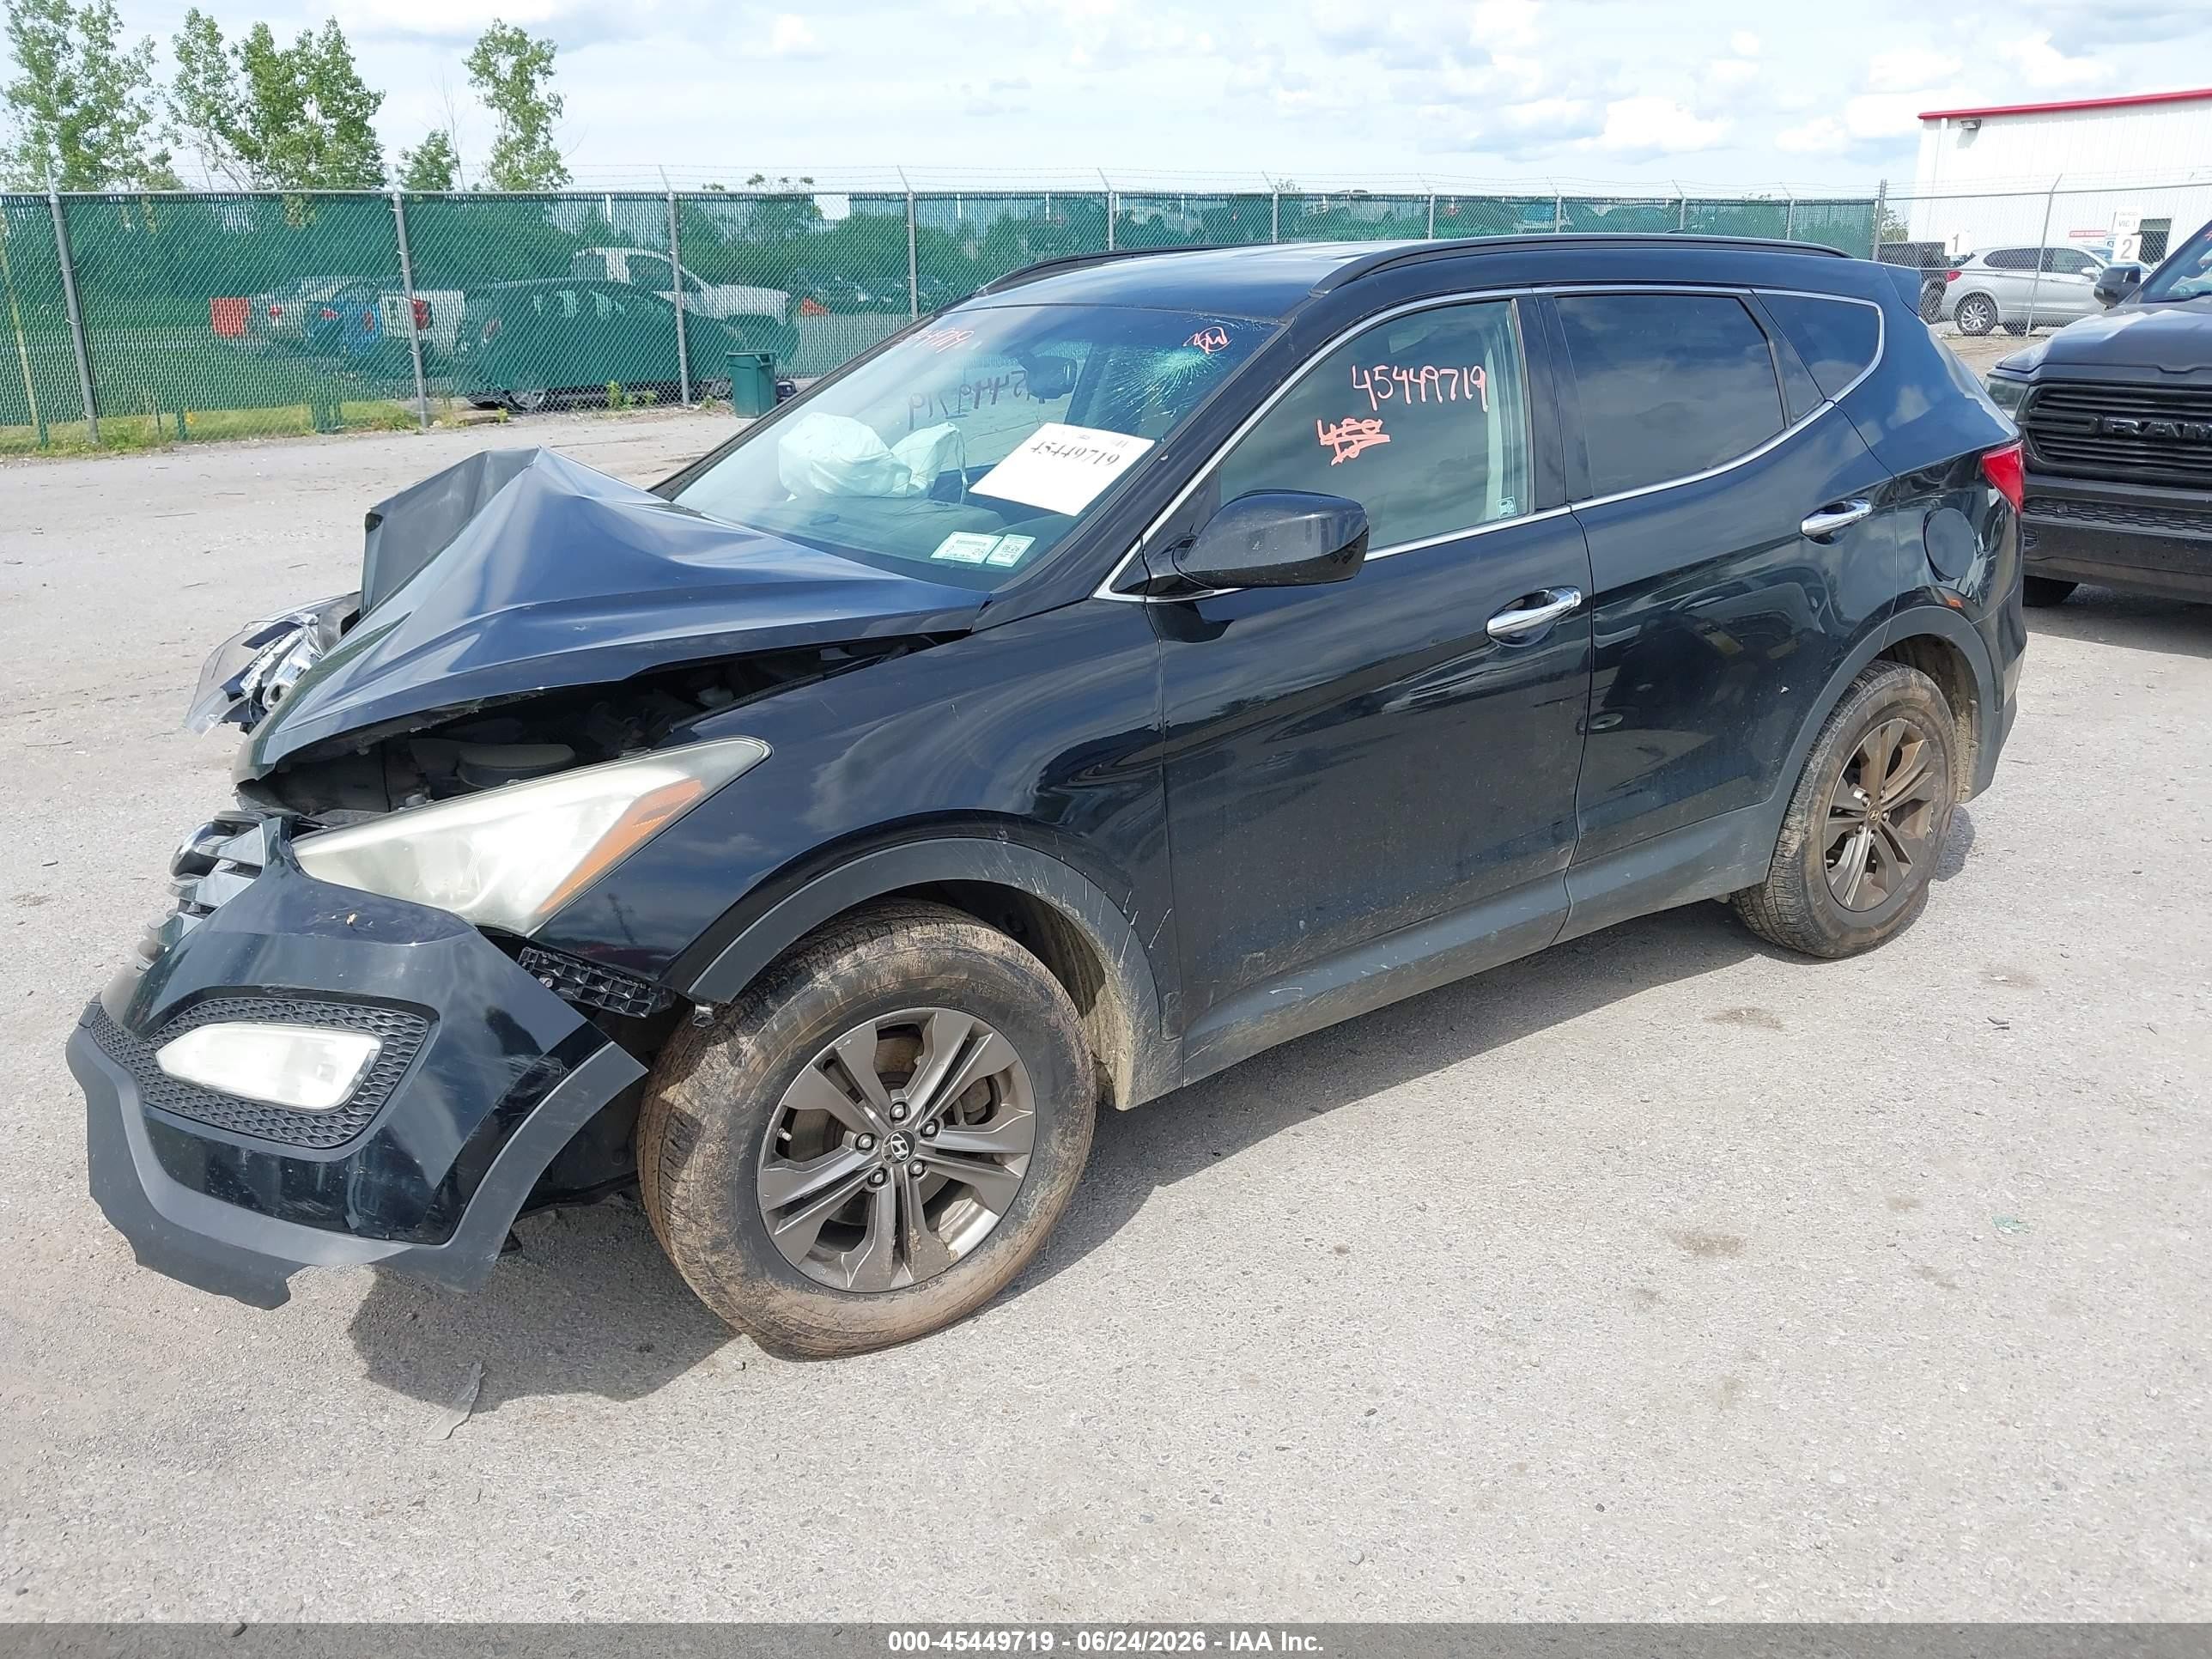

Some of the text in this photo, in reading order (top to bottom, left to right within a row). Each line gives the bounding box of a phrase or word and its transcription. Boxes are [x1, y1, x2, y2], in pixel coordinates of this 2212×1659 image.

[1952, 233, 1960, 253] 1
[2119, 239, 2133, 259] 2
[1352, 364, 1489, 412] 45449719
[1030, 441, 1121, 466] 45449719
